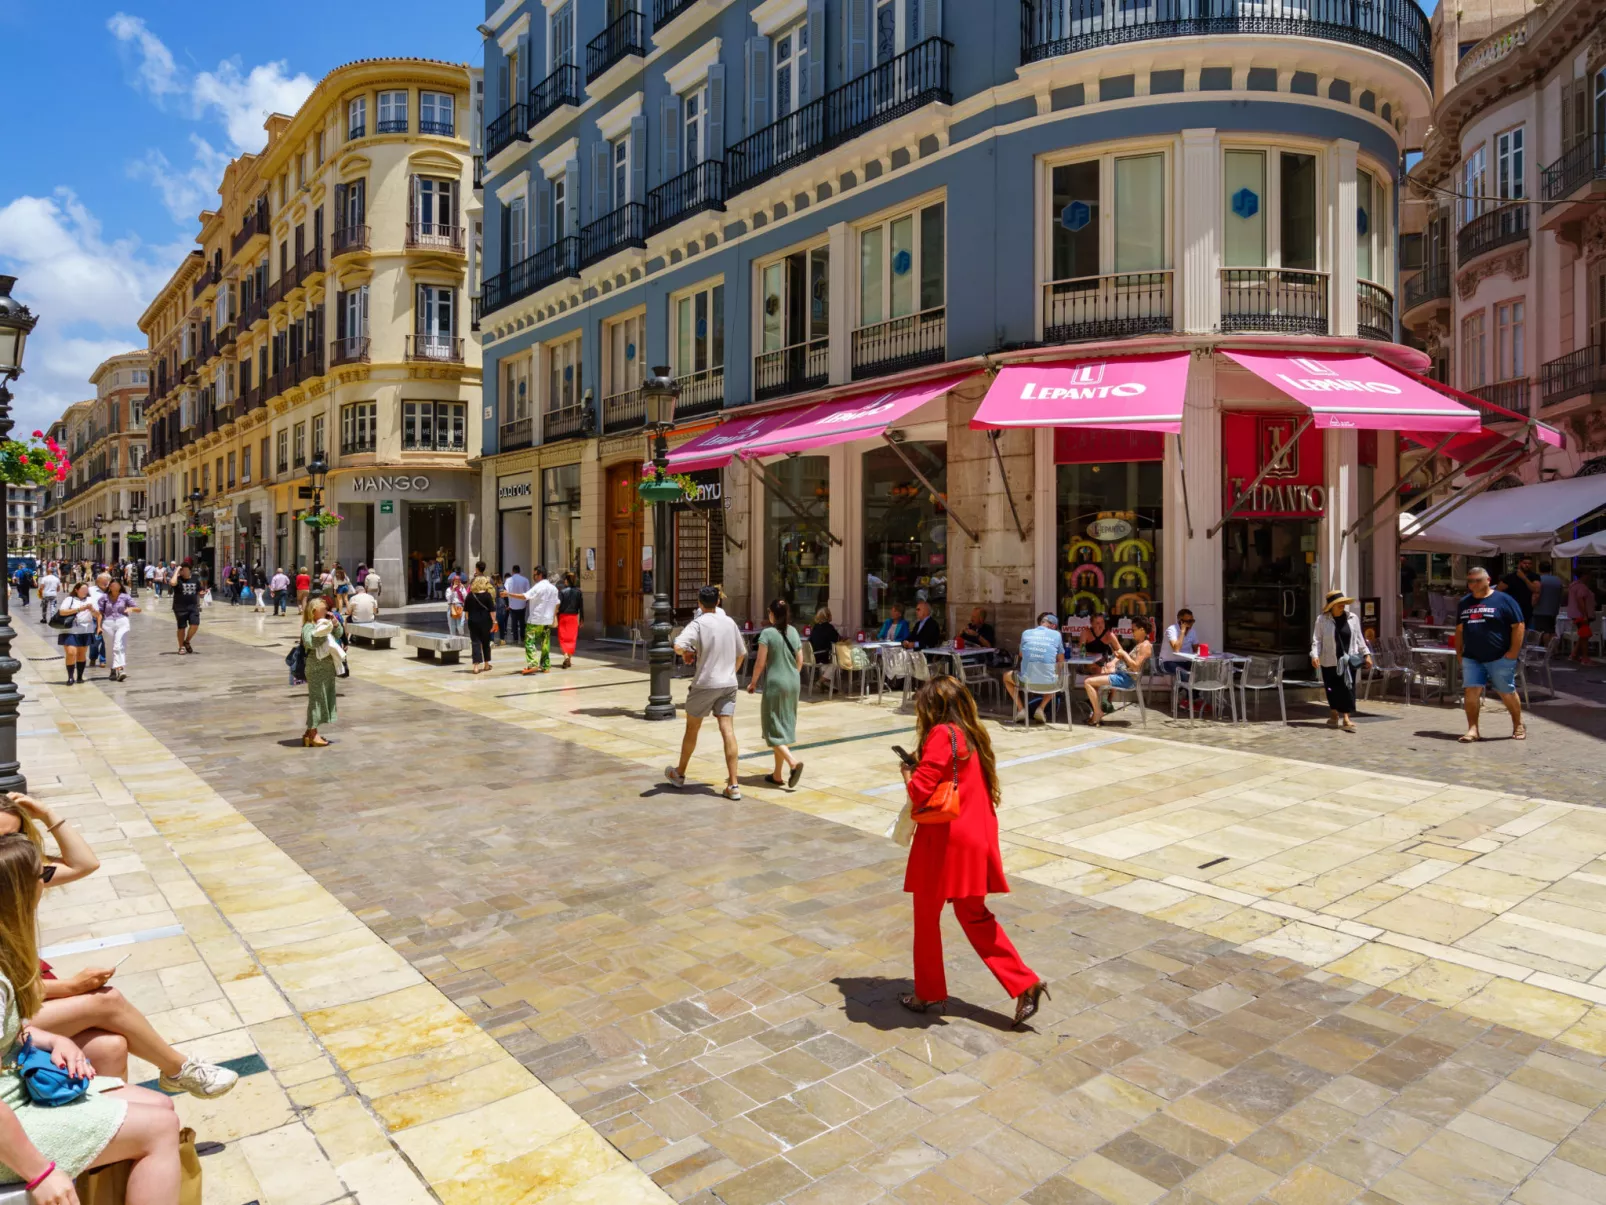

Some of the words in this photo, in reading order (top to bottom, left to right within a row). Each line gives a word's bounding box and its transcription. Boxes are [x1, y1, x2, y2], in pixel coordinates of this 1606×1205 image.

[1020, 382, 1147, 400] LEPANTO
[1276, 373, 1402, 394] LEPANTO
[815, 402, 895, 425] LEPANTO
[352, 475, 430, 492] MANGO
